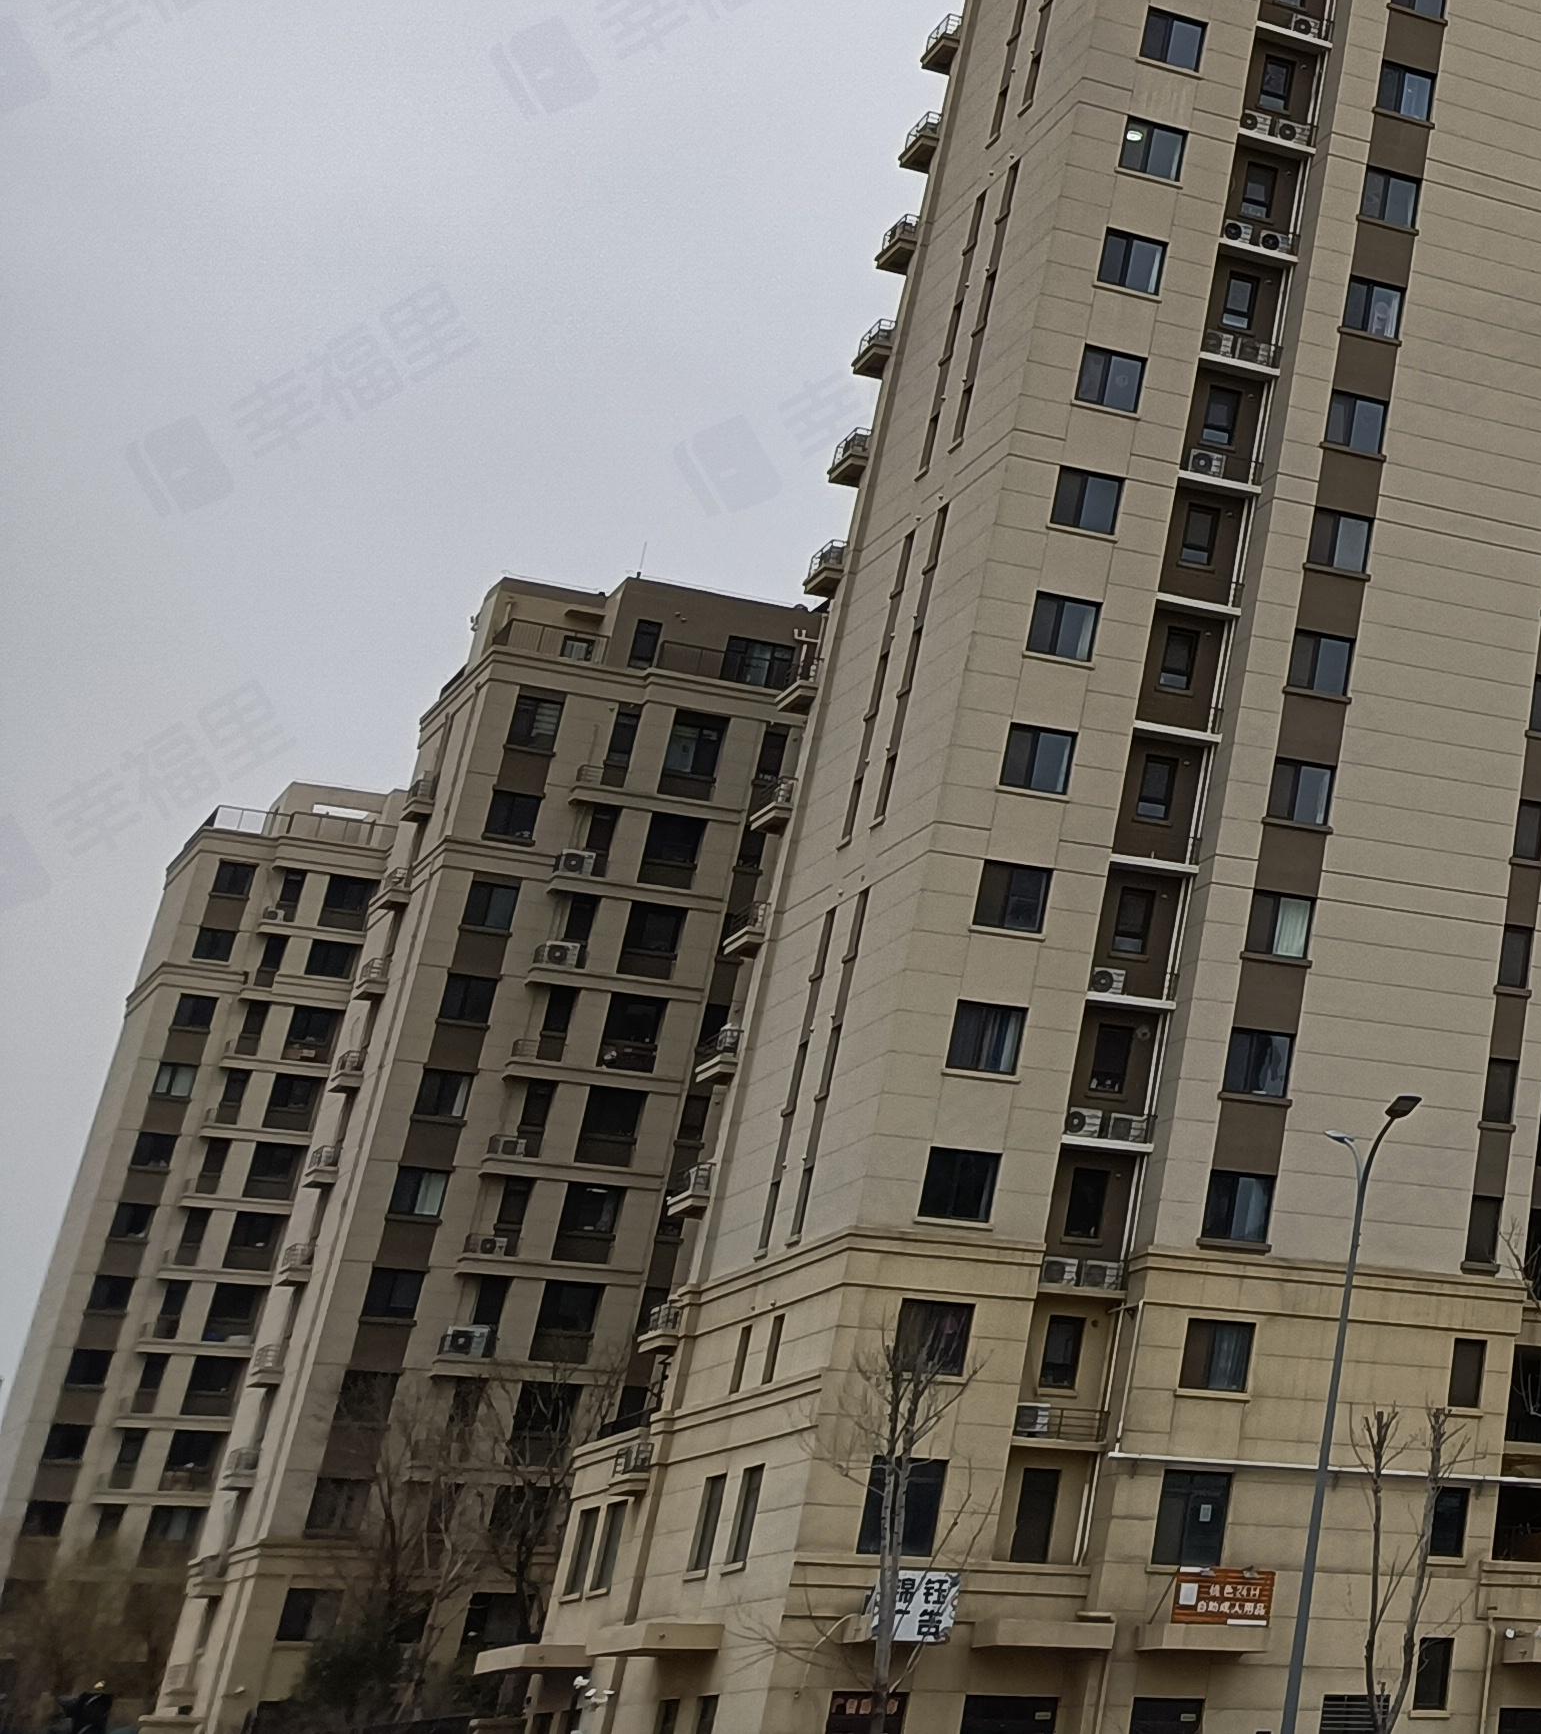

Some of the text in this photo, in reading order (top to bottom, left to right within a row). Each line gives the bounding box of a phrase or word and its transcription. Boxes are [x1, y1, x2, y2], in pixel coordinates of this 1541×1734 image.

[1197, 1601, 1266, 1615] 自助成人用品
